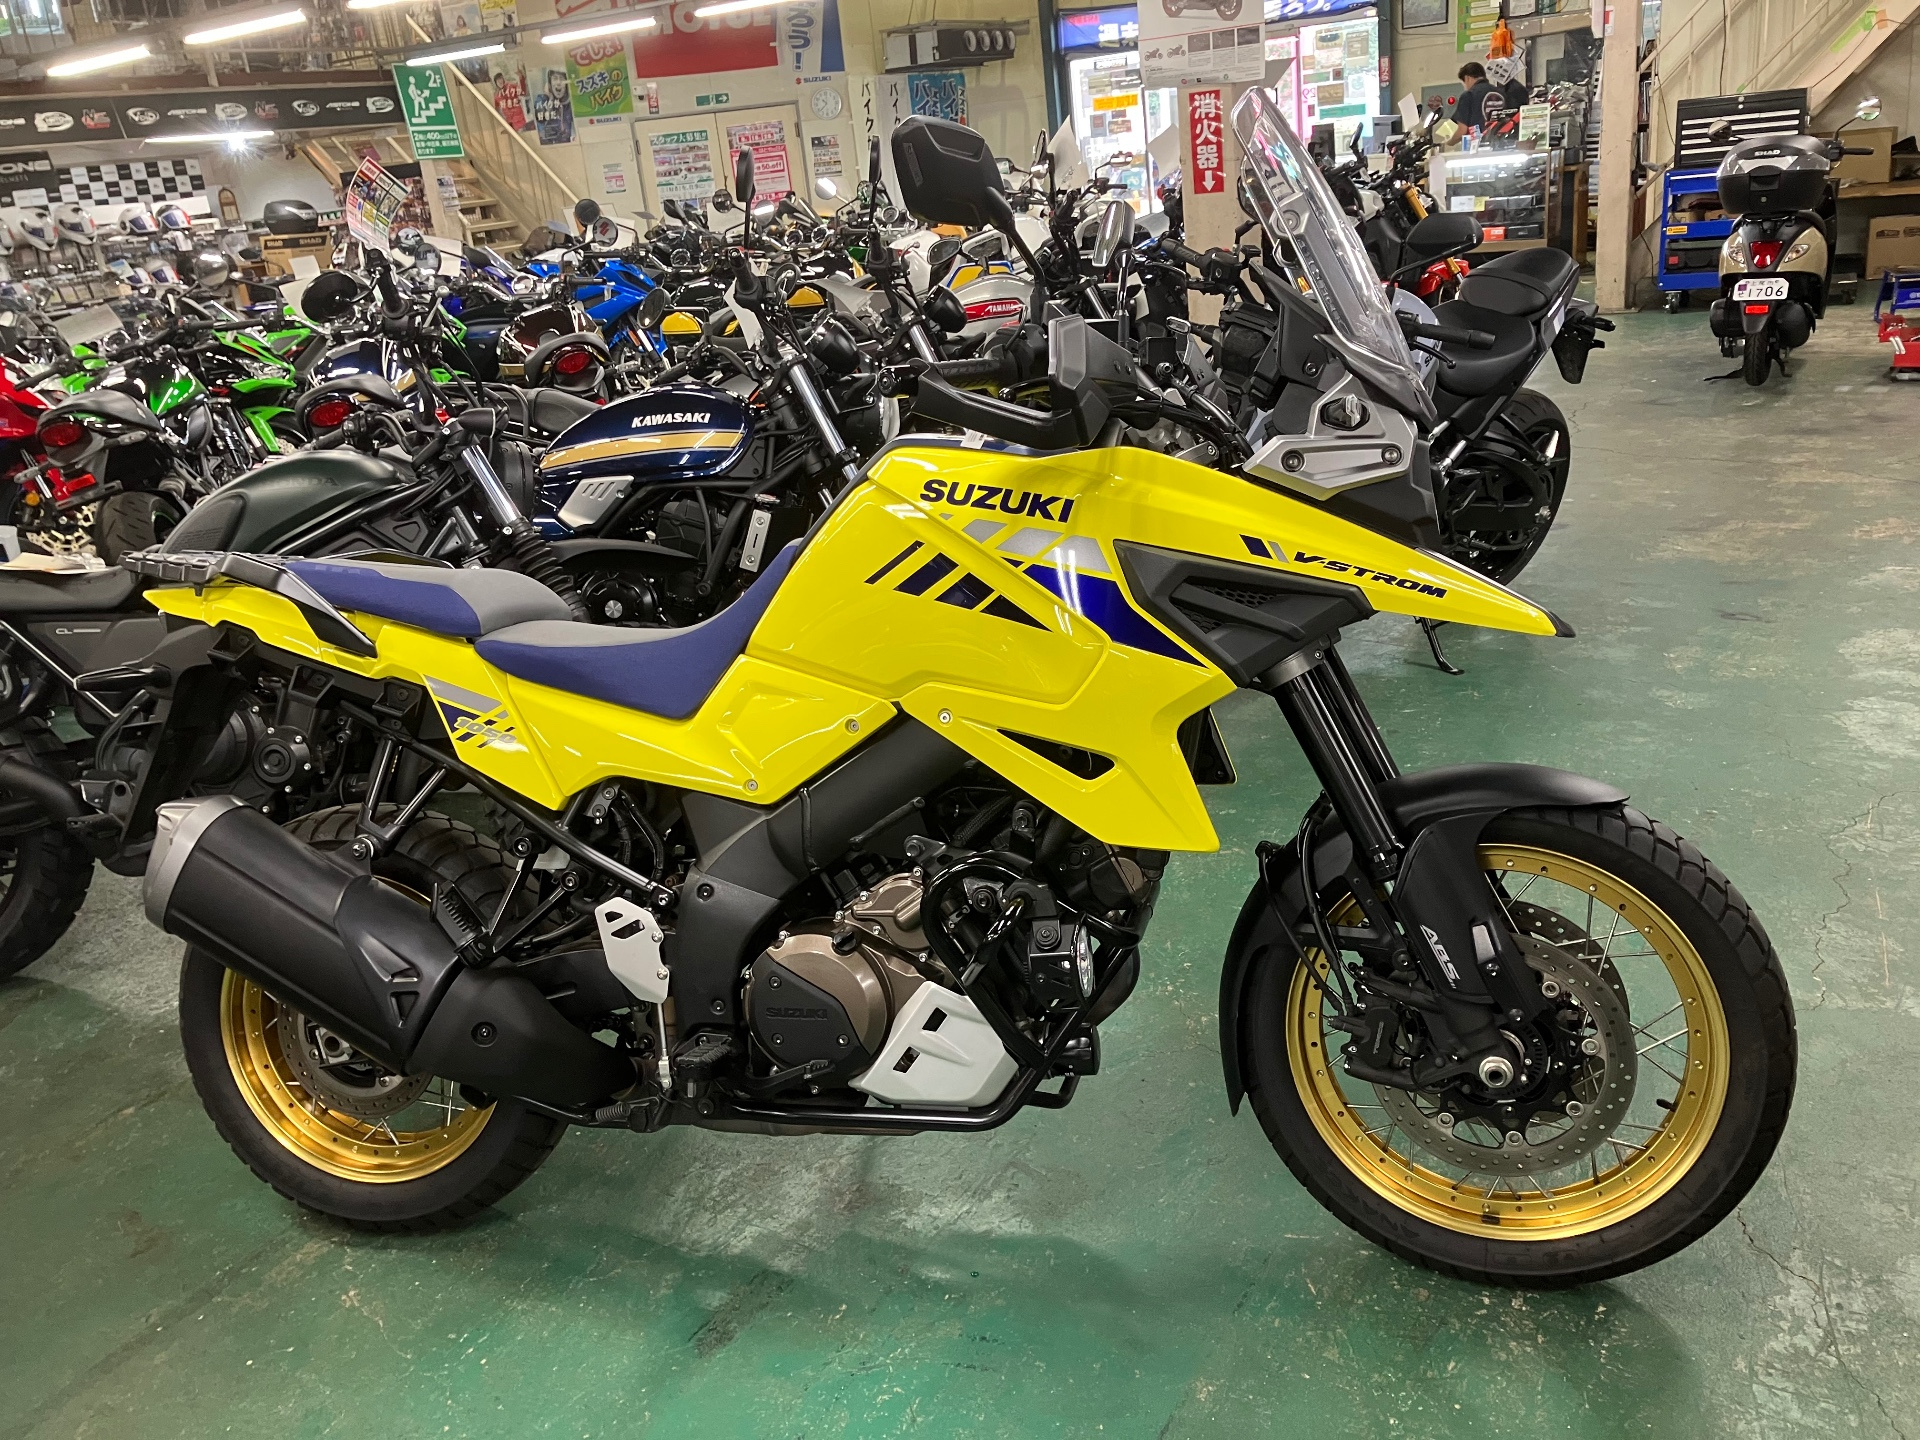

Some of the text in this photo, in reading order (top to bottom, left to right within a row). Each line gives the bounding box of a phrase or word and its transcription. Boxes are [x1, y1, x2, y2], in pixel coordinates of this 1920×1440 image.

[426, 70, 441, 87] 2F
[590, 83, 623, 110] バイク
[596, 116, 622, 124] SUZUKI
[1193, 92, 1219, 170] 消火器
[1748, 286, 1783, 298] 1706
[631, 412, 711, 429] KAWASAKI
[919, 479, 1075, 524] SUZUKI
[1293, 551, 1448, 599] V-STROM
[454, 717, 517, 744] 1050
[1420, 924, 1461, 981] ABS
[766, 1007, 828, 1020] SUZUKI
